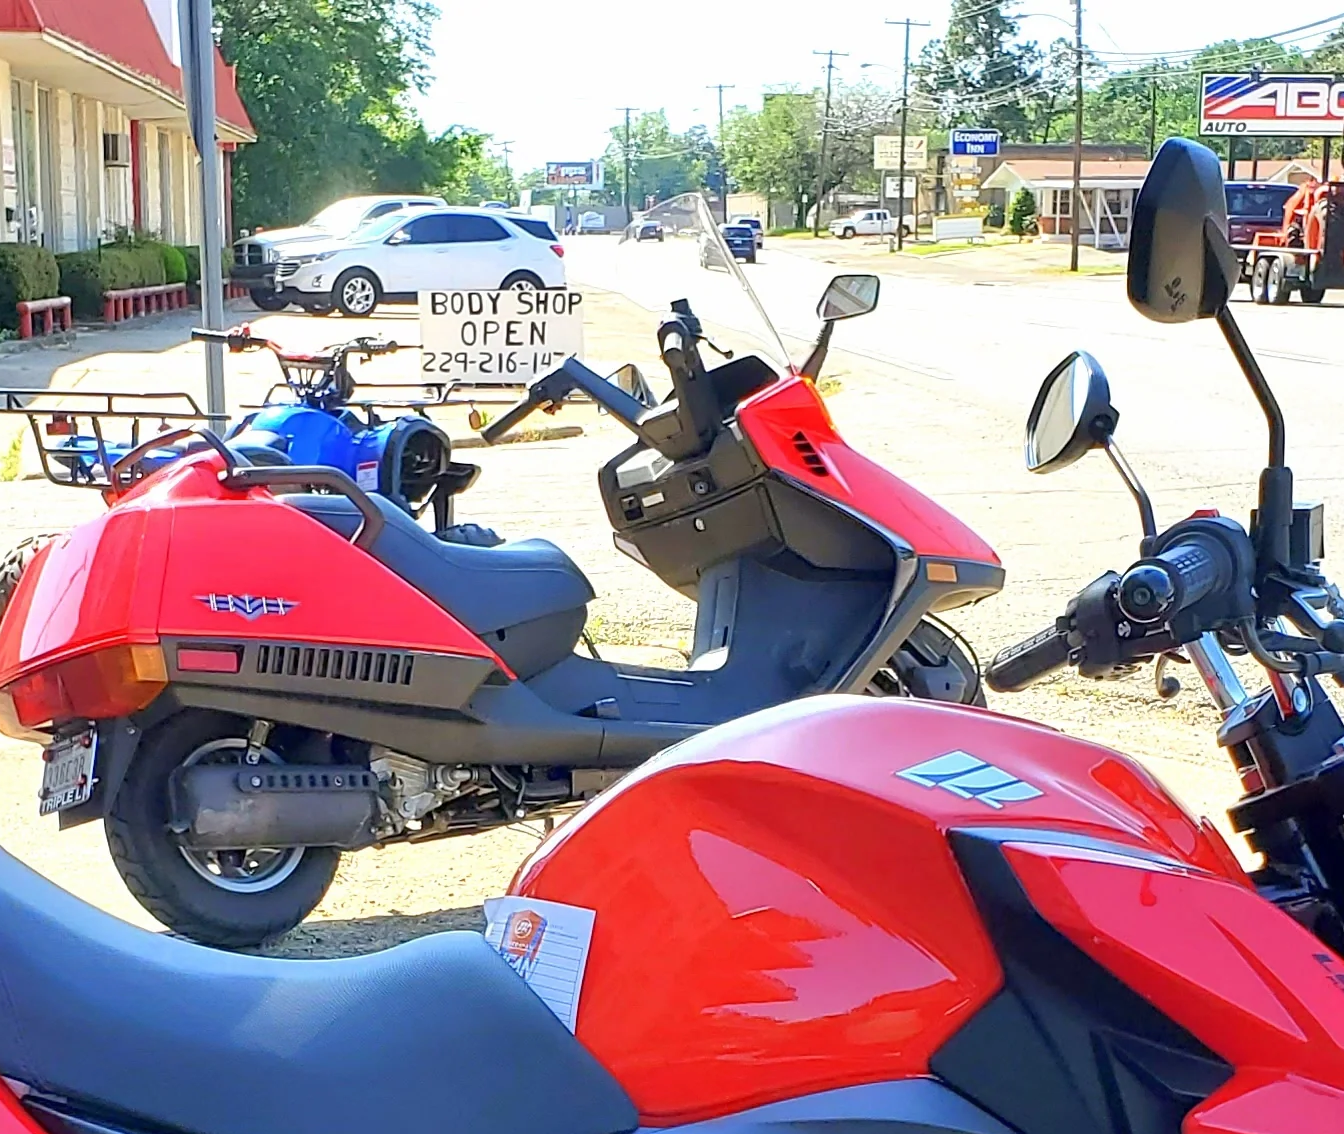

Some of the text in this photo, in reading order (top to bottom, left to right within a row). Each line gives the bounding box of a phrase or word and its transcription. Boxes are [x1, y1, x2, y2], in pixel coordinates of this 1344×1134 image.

[954, 132, 998, 143] ECONOMY
[1203, 121, 1247, 133] AUTO
[430, 292, 583, 315] BODY SHOP
[461, 321, 546, 346] OPEN
[208, 593, 286, 615] HELIX
[42, 790, 74, 812] TRIPLE
